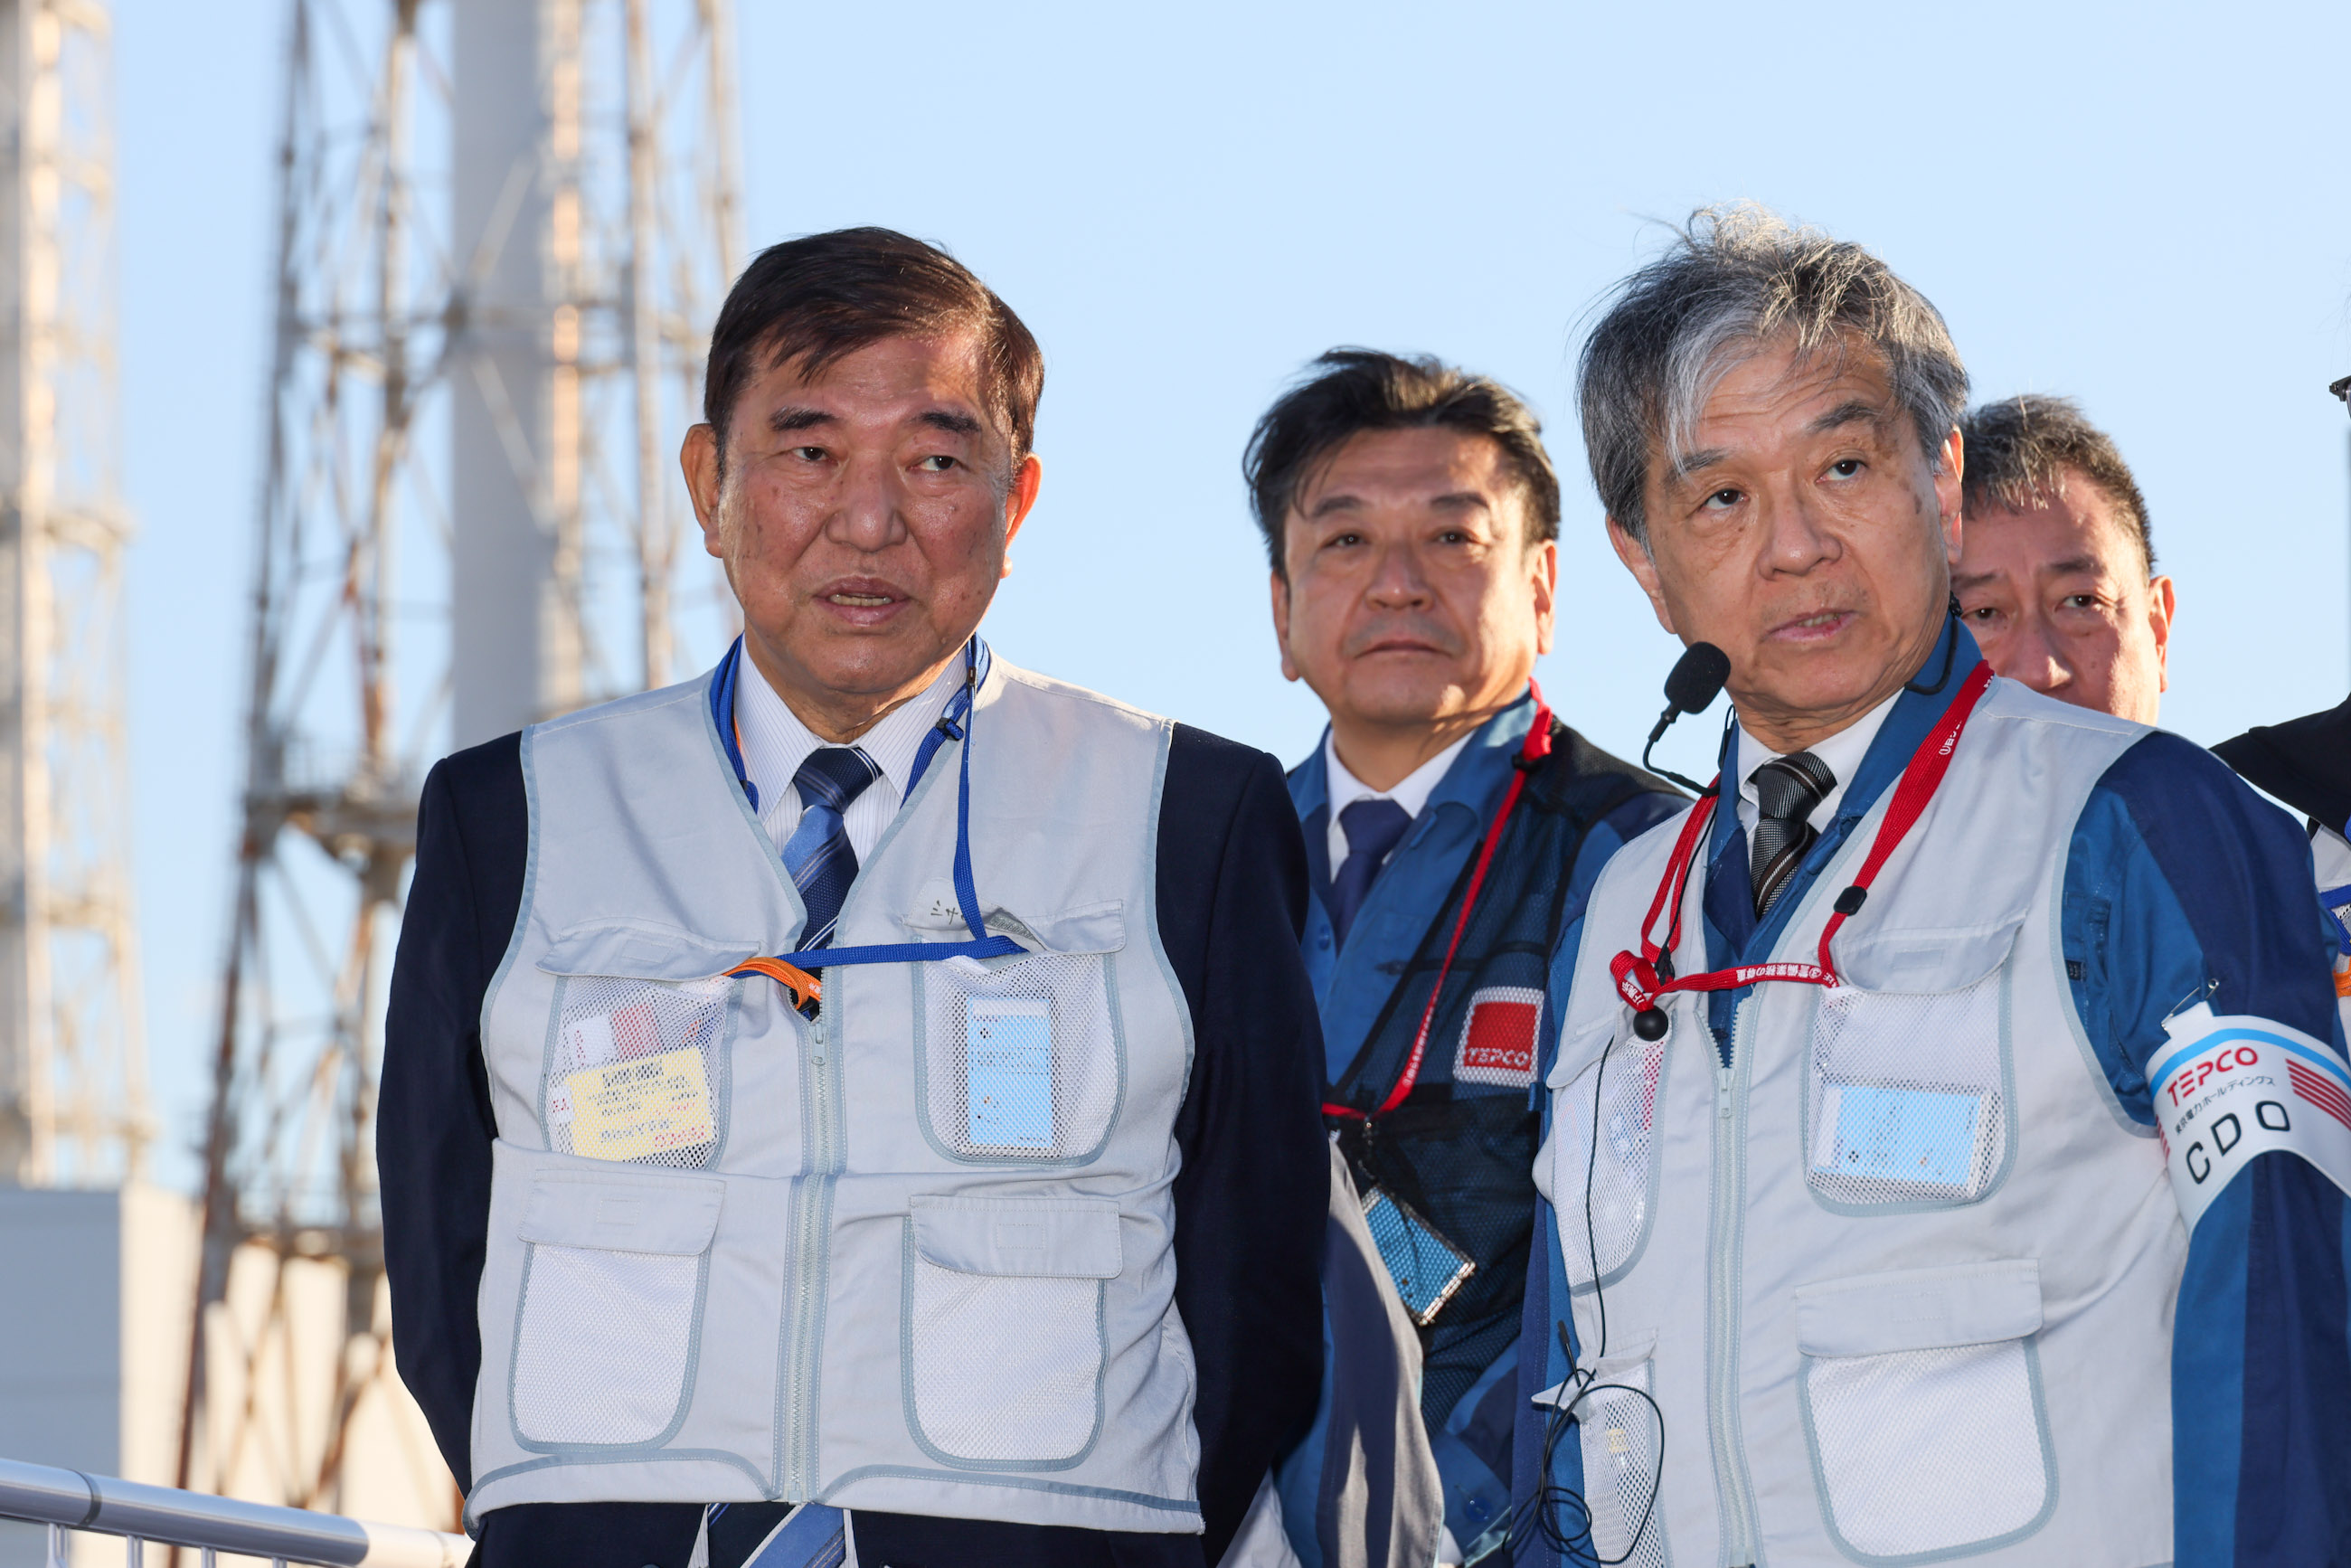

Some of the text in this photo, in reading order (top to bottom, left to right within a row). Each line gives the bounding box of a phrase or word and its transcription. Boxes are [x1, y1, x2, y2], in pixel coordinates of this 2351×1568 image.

[1468, 1047, 1529, 1067] TEPCO
[2167, 1046, 2258, 1108] TEPCO
[2176, 1075, 2275, 1135] 東京電力ホールディングス
[2186, 1100, 2290, 1185] CDO
